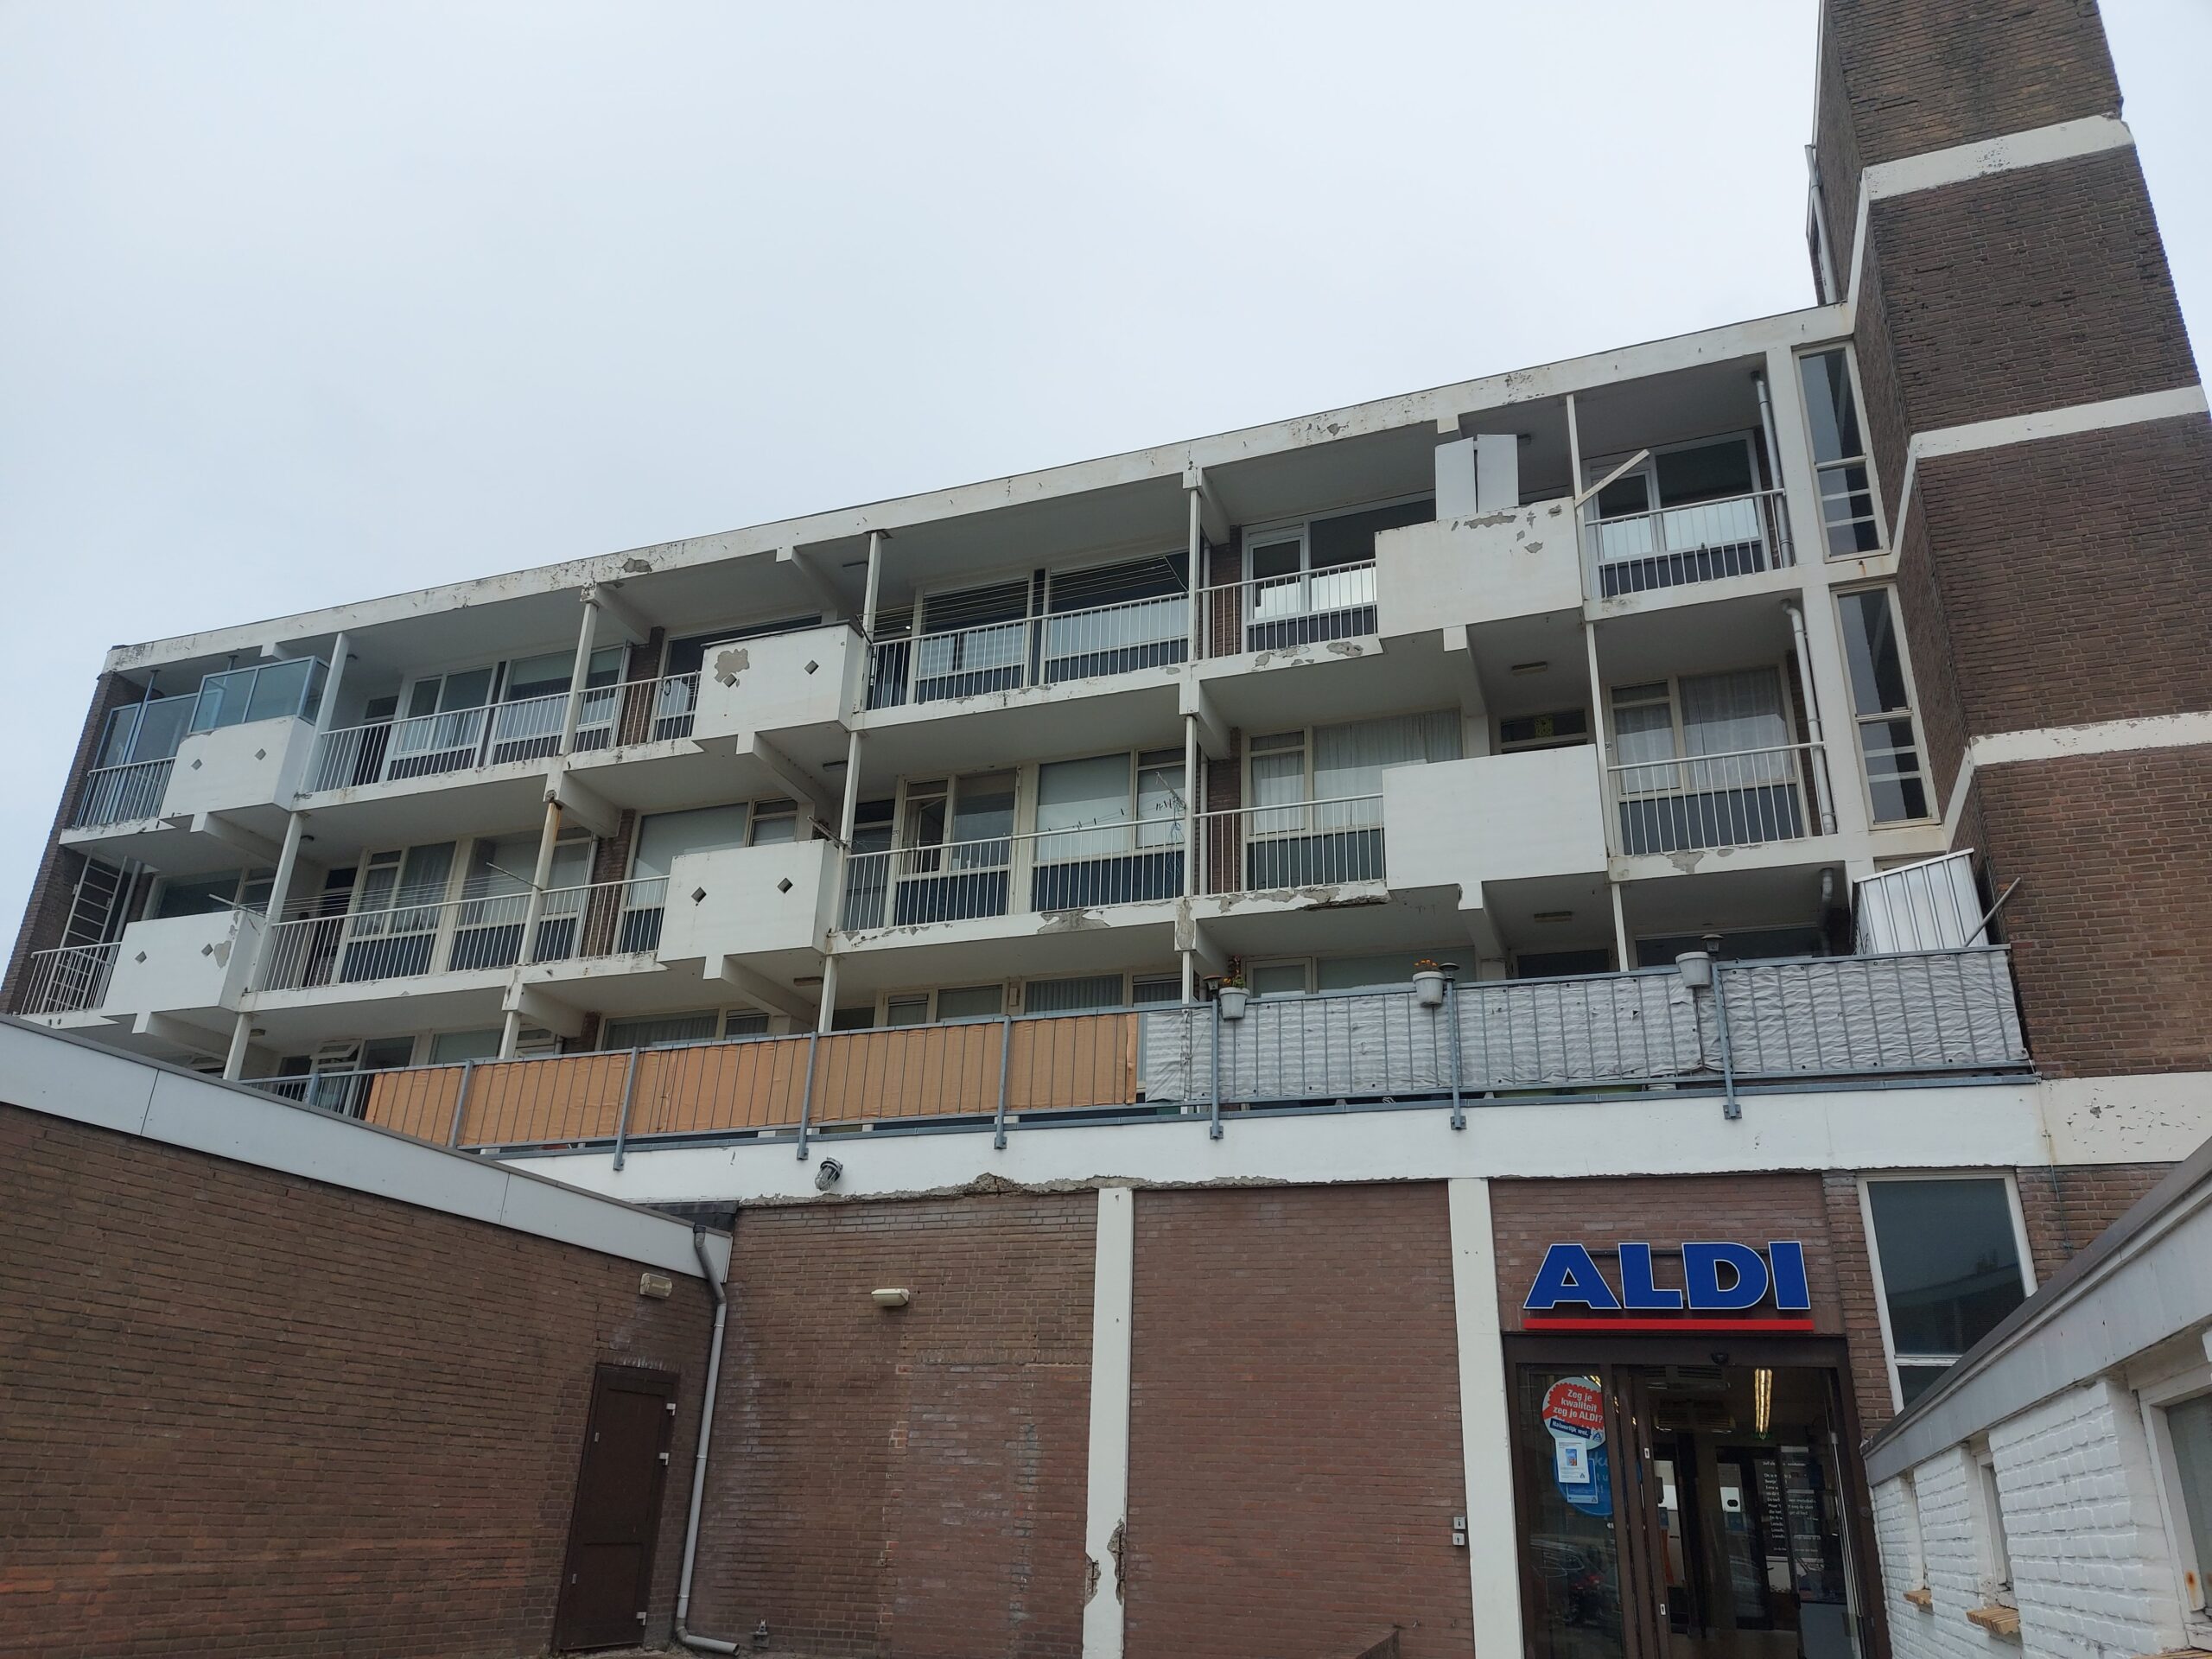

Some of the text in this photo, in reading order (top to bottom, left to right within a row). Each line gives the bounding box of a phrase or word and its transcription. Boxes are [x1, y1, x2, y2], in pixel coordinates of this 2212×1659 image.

[1522, 1241, 1811, 1310] ALDI
[1567, 1389, 1592, 1402] Zeg je
[1561, 1397, 1597, 1412] kwaliteit
[1553, 1407, 1603, 1423] zeg je ALDI?
[1552, 1420, 1577, 1433] Natuurlijk
